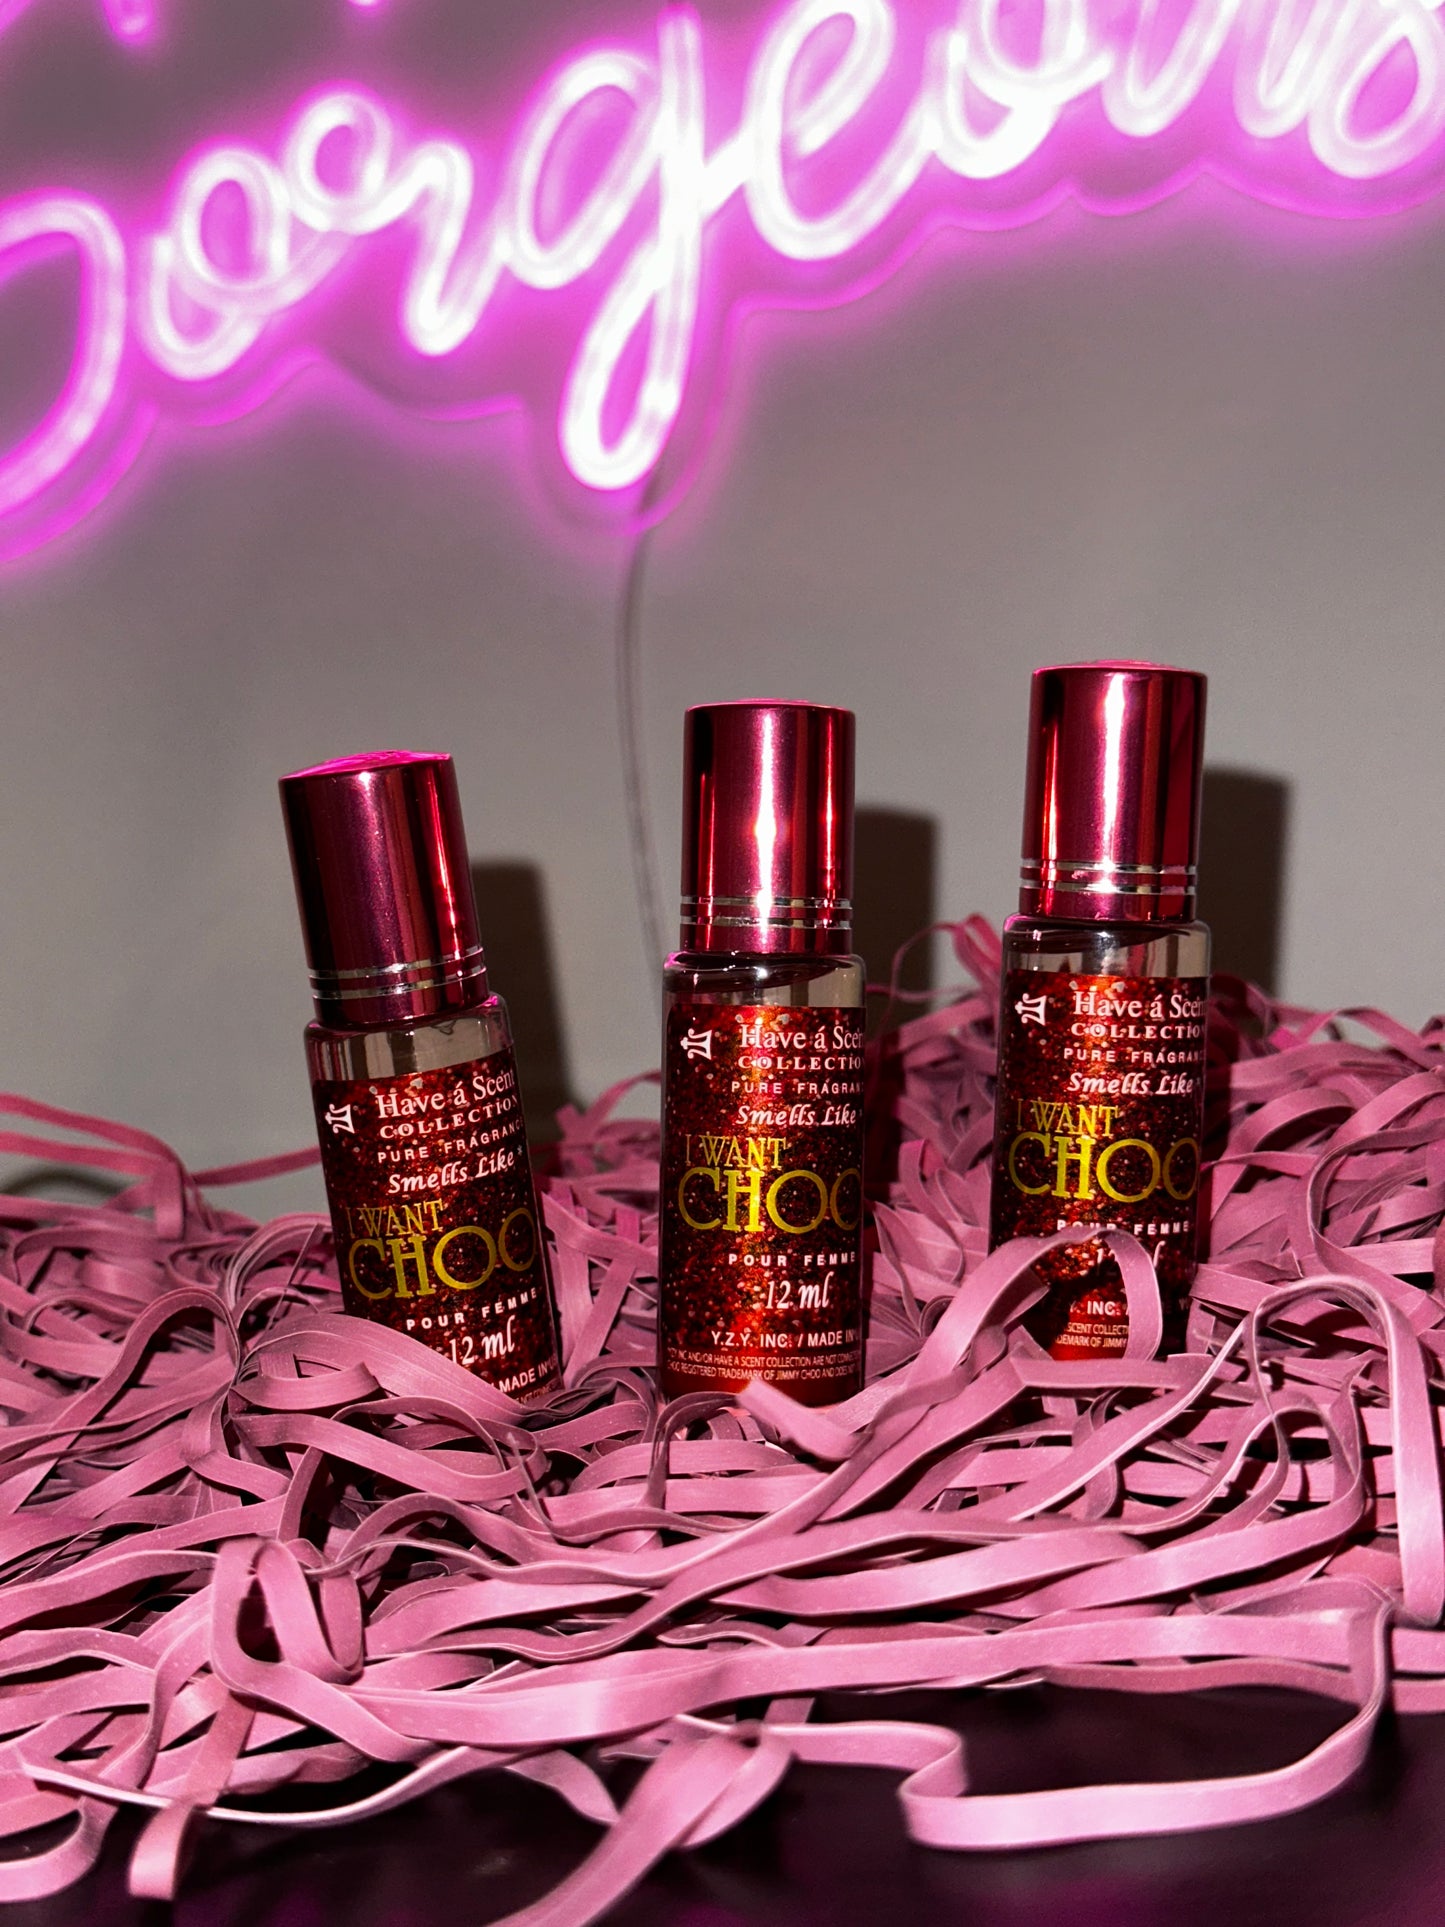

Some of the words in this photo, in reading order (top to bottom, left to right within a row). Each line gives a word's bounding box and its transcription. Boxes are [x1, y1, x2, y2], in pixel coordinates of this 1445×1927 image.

[0, 0, 1445, 515] orgeous
[1074, 991, 1143, 1018] Have
[740, 1023, 807, 1049] Have
[1071, 1024, 1204, 1039] COLLECTIO
[1064, 1047, 1116, 1062] PURE
[1131, 1050, 1203, 1063] FRAGRAN
[731, 1081, 782, 1094] PURE
[797, 1082, 863, 1094] FRAGRAN
[1068, 1072, 1150, 1095] Smells
[1155, 1072, 1194, 1095] Like
[376, 1092, 445, 1119] Have
[735, 1103, 816, 1126] Smells
[821, 1103, 856, 1126] Like
[1031, 1100, 1118, 1137] WANT
[378, 1146, 430, 1164] PURE
[444, 1118, 523, 1154] FRAGRANC
[701, 1135, 787, 1170] WANT
[388, 1161, 468, 1194] Smells
[476, 1148, 516, 1179] Like
[1008, 1131, 1198, 1203] CHOO
[678, 1167, 861, 1234] CHOO
[358, 1198, 446, 1237] WANT
[1133, 1221, 1190, 1235] FEMME
[349, 1208, 537, 1300] CHOO
[728, 1253, 788, 1267] POUR
[804, 1252, 856, 1267] FEMME
[766, 1280, 791, 1309] 12
[799, 1272, 834, 1309] ml
[406, 1311, 465, 1331] POUR
[482, 1287, 537, 1318] FEMME
[450, 1335, 475, 1367] 12
[482, 1315, 516, 1360] ml
[711, 1330, 754, 1347] Y.Z.Y.
[807, 1330, 843, 1348] MADE
[1067, 1321, 1092, 1335] SCENT
[1090, 1336, 1101, 1348] OF
[1102, 1337, 1127, 1349] JIMMY
[741, 1356, 765, 1368] SCENT
[766, 1356, 811, 1368] COLLECTION
[812, 1355, 825, 1366] ARE
[498, 1368, 537, 1393] MADE
[763, 1369, 775, 1381] OF
[775, 1370, 800, 1381] JIMMY
